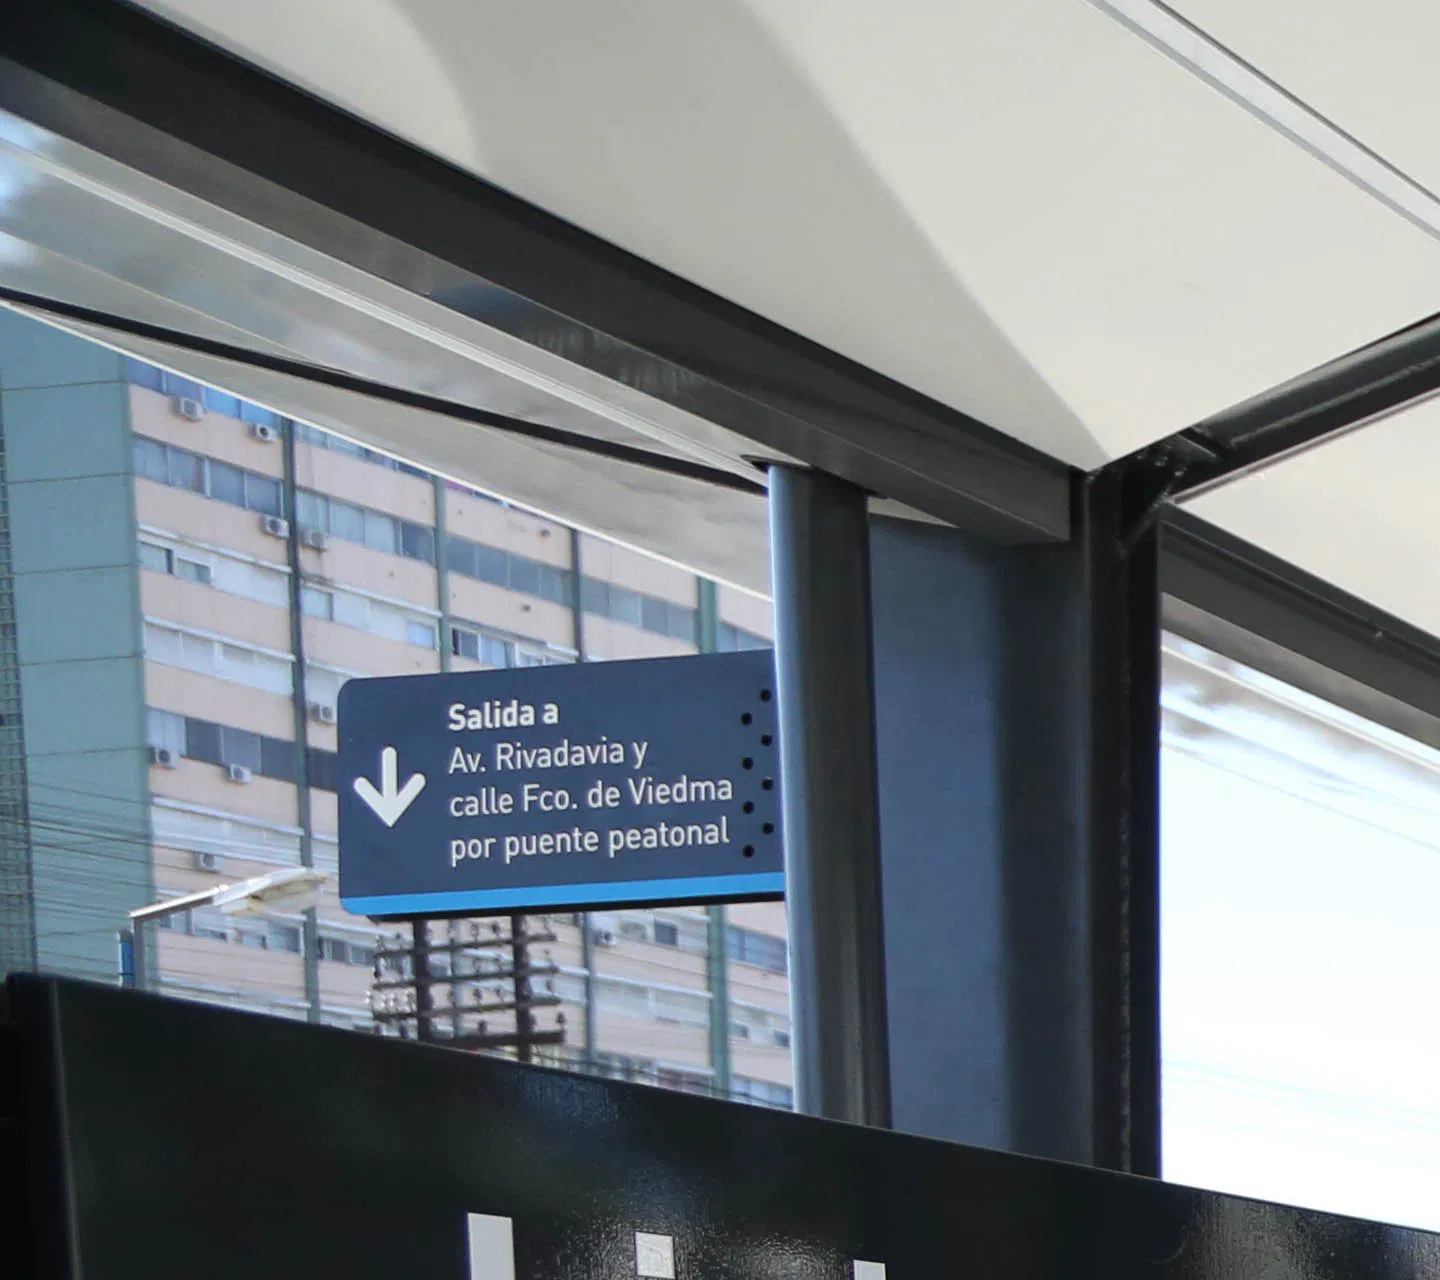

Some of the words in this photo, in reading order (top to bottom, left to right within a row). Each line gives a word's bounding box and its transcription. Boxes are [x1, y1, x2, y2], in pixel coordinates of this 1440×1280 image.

[448, 699, 535, 731] Salida
[542, 703, 559, 725] a
[448, 746, 486, 774] Av.
[496, 735, 625, 771] Rivadavia
[632, 741, 648, 770] y
[449, 786, 514, 817] calle
[523, 783, 578, 812] Fco.
[587, 779, 621, 809] de
[627, 774, 733, 805] Viedma
[451, 836, 497, 868] por
[504, 827, 599, 865] puente
[608, 815, 730, 858] peatonal
